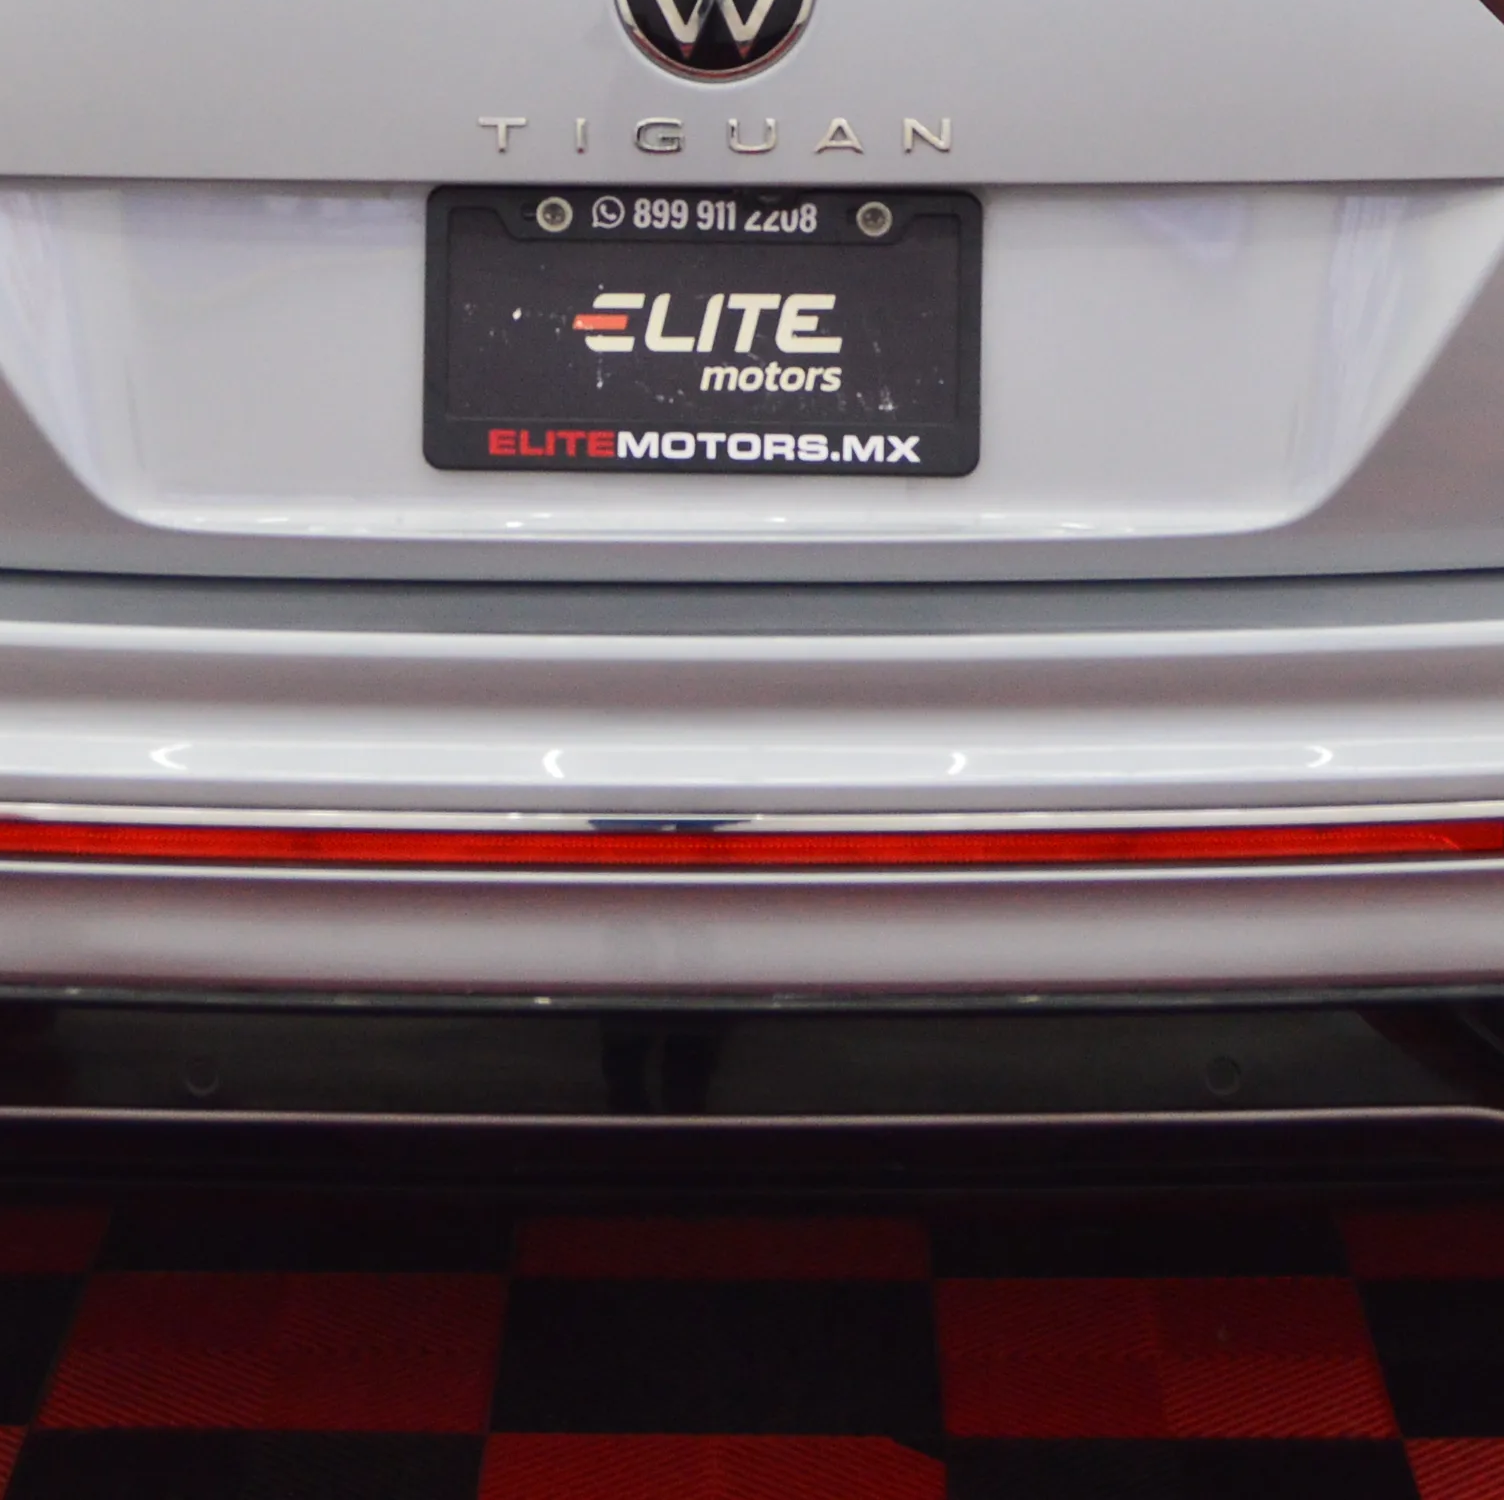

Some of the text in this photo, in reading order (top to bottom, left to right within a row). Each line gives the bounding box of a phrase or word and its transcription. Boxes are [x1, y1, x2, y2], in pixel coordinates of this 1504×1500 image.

[477, 116, 953, 155] TIGUAN
[633, 199, 689, 229] 899
[696, 200, 737, 231] 911
[572, 293, 843, 354] ELITE
[699, 363, 842, 393] motors
[488, 429, 921, 463] ELITEMOTORS.MX
